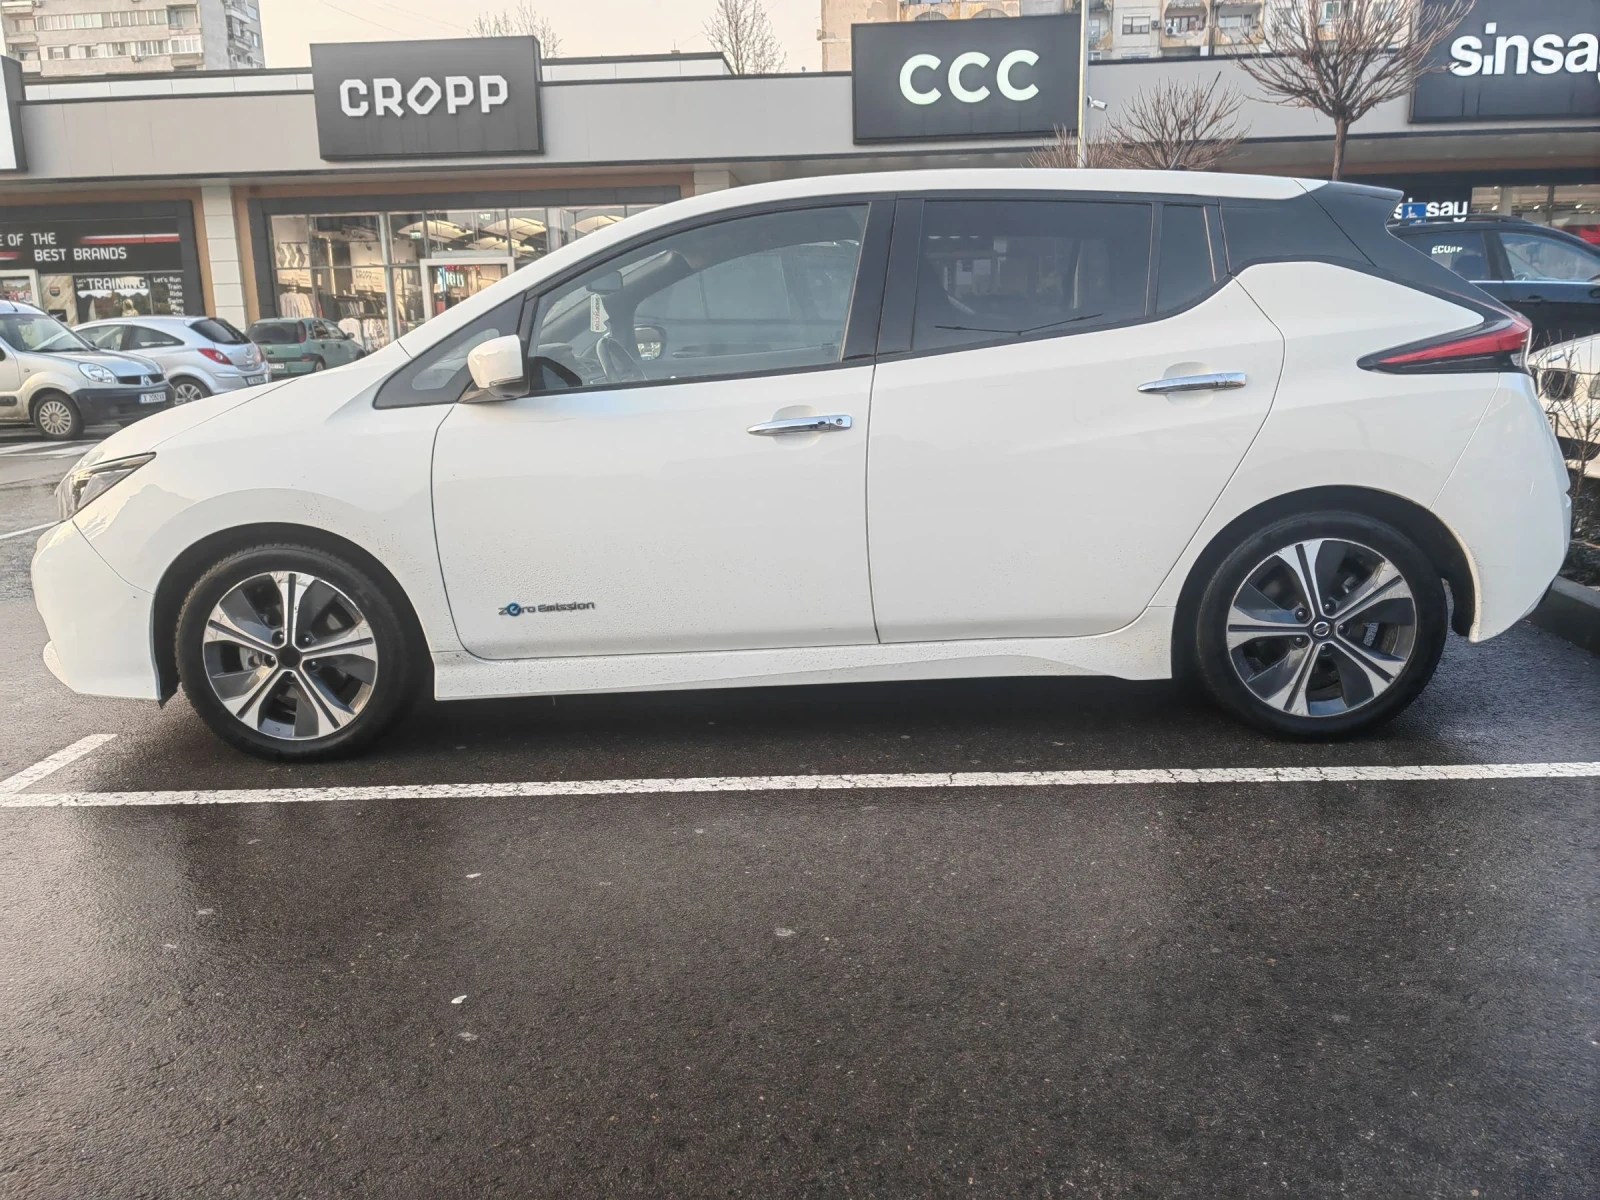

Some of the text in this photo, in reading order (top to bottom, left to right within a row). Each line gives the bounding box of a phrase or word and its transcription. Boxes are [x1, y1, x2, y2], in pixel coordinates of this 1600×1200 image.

[1450, 22, 1600, 83] sinsa
[899, 49, 1039, 105] CCC
[339, 75, 508, 117] CROPP
[1393, 197, 1468, 223] ssay
[7, 233, 24, 247] OF
[30, 232, 57, 245] THE
[34, 247, 127, 262] BEST BRANDS
[87, 277, 147, 290] TRAINING
[537, 601, 595, 613] Emission
